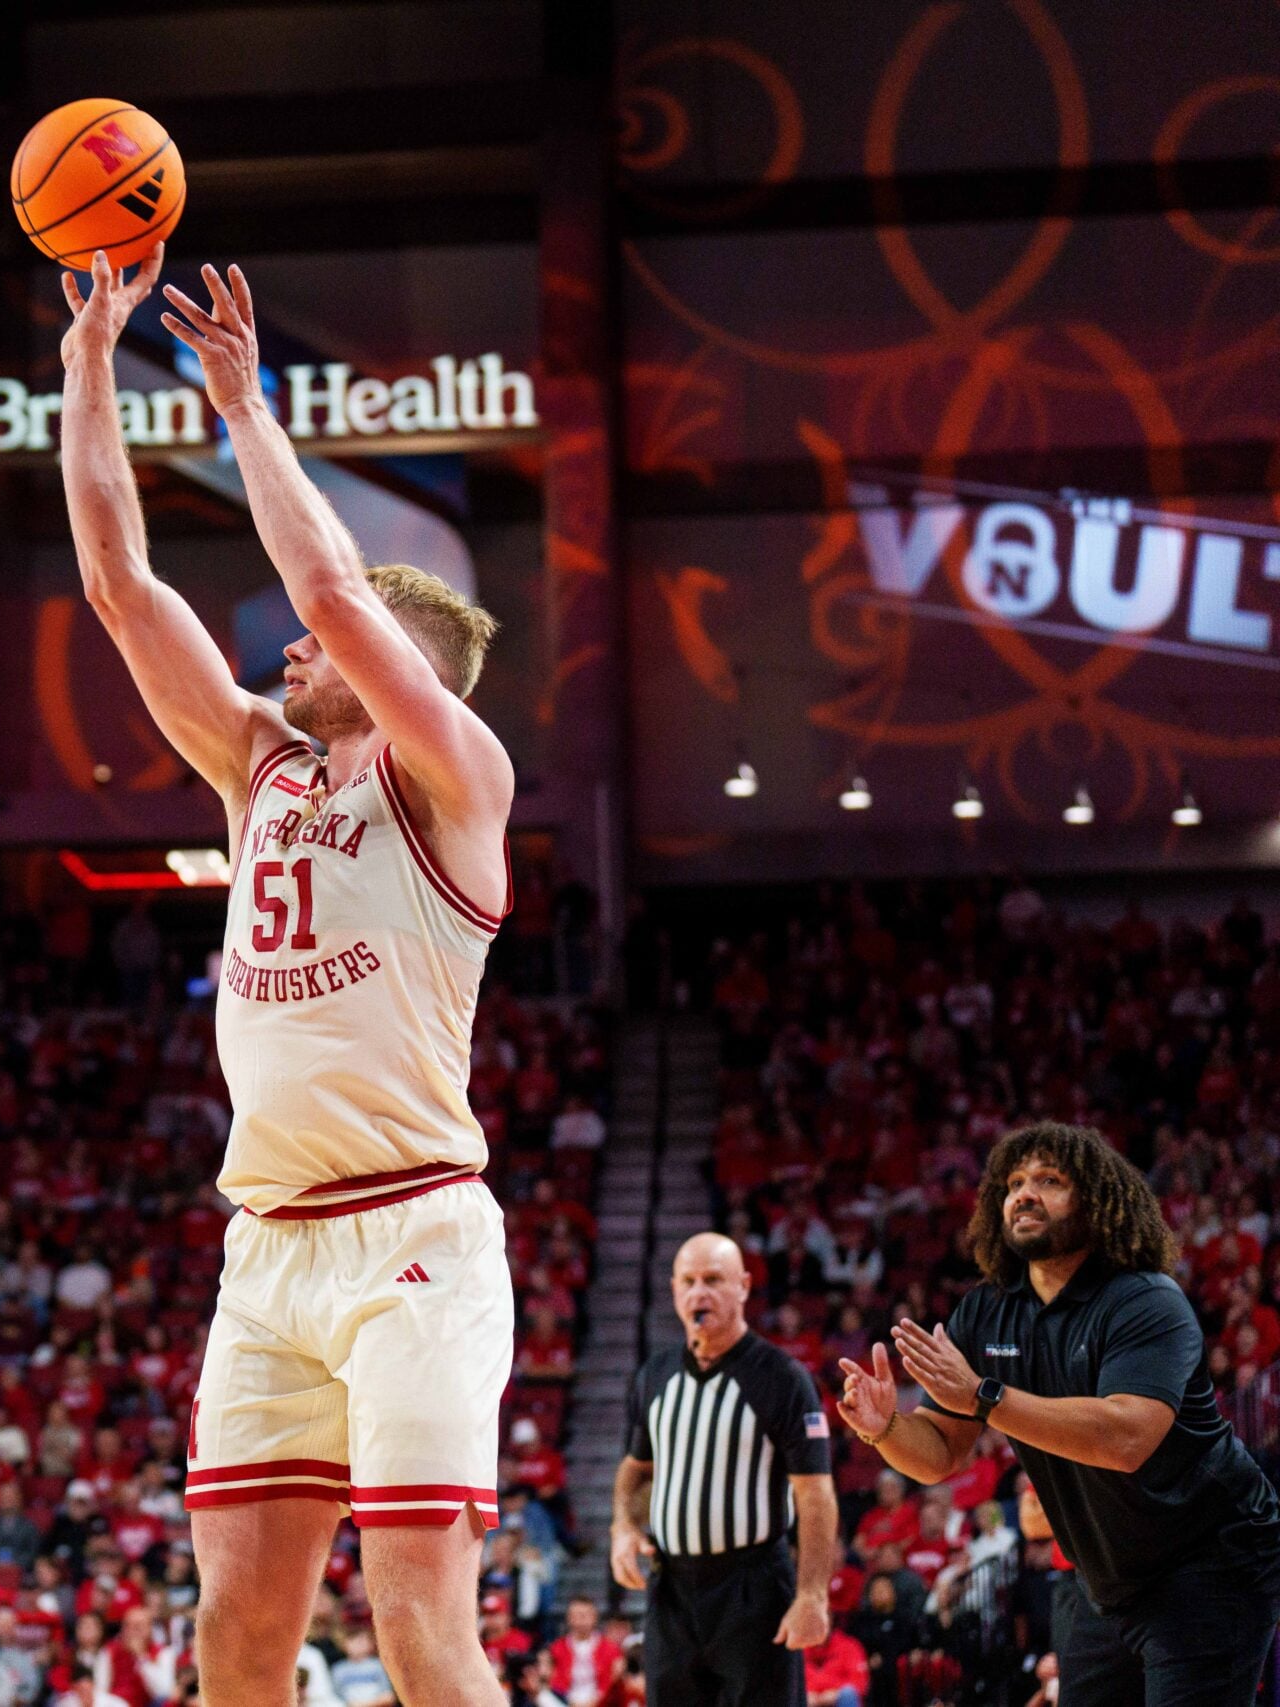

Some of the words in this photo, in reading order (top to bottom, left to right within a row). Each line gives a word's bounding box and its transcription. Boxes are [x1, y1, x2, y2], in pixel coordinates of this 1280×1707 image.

[82, 121, 142, 175] N
[285, 352, 538, 438] Health
[251, 857, 317, 953] 51
[226, 941, 381, 1003] CORNHUSKERS
